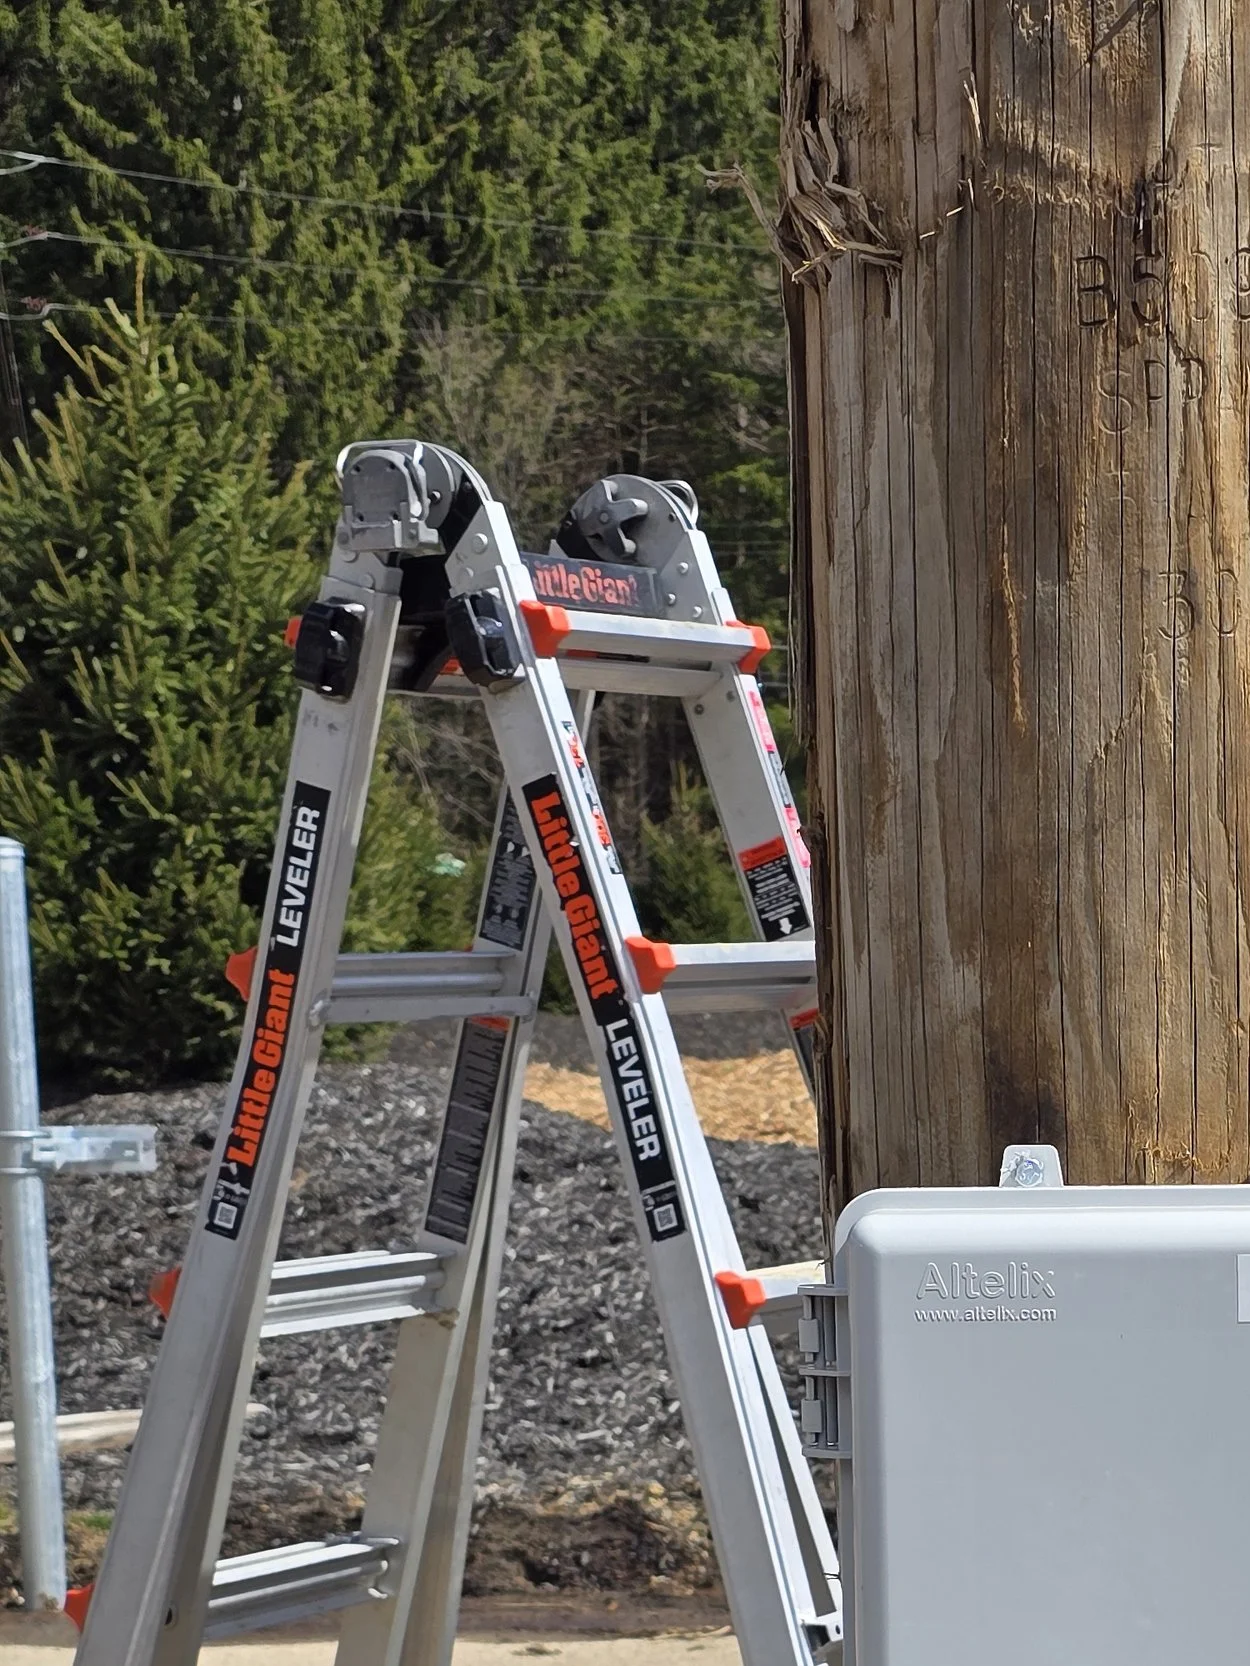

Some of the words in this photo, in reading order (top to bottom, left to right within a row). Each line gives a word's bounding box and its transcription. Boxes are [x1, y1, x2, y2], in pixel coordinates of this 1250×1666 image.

[226, 1069, 276, 1168] Little
[252, 968, 296, 1068] Giant
[275, 805, 321, 947] LEVELER
[530, 789, 580, 895] Little
[564, 893, 619, 1000] Giant
[605, 1017, 661, 1162] LEVELER
[914, 1305, 1058, 1322] www.altelix.com
[916, 1261, 1057, 1299] Altelix
